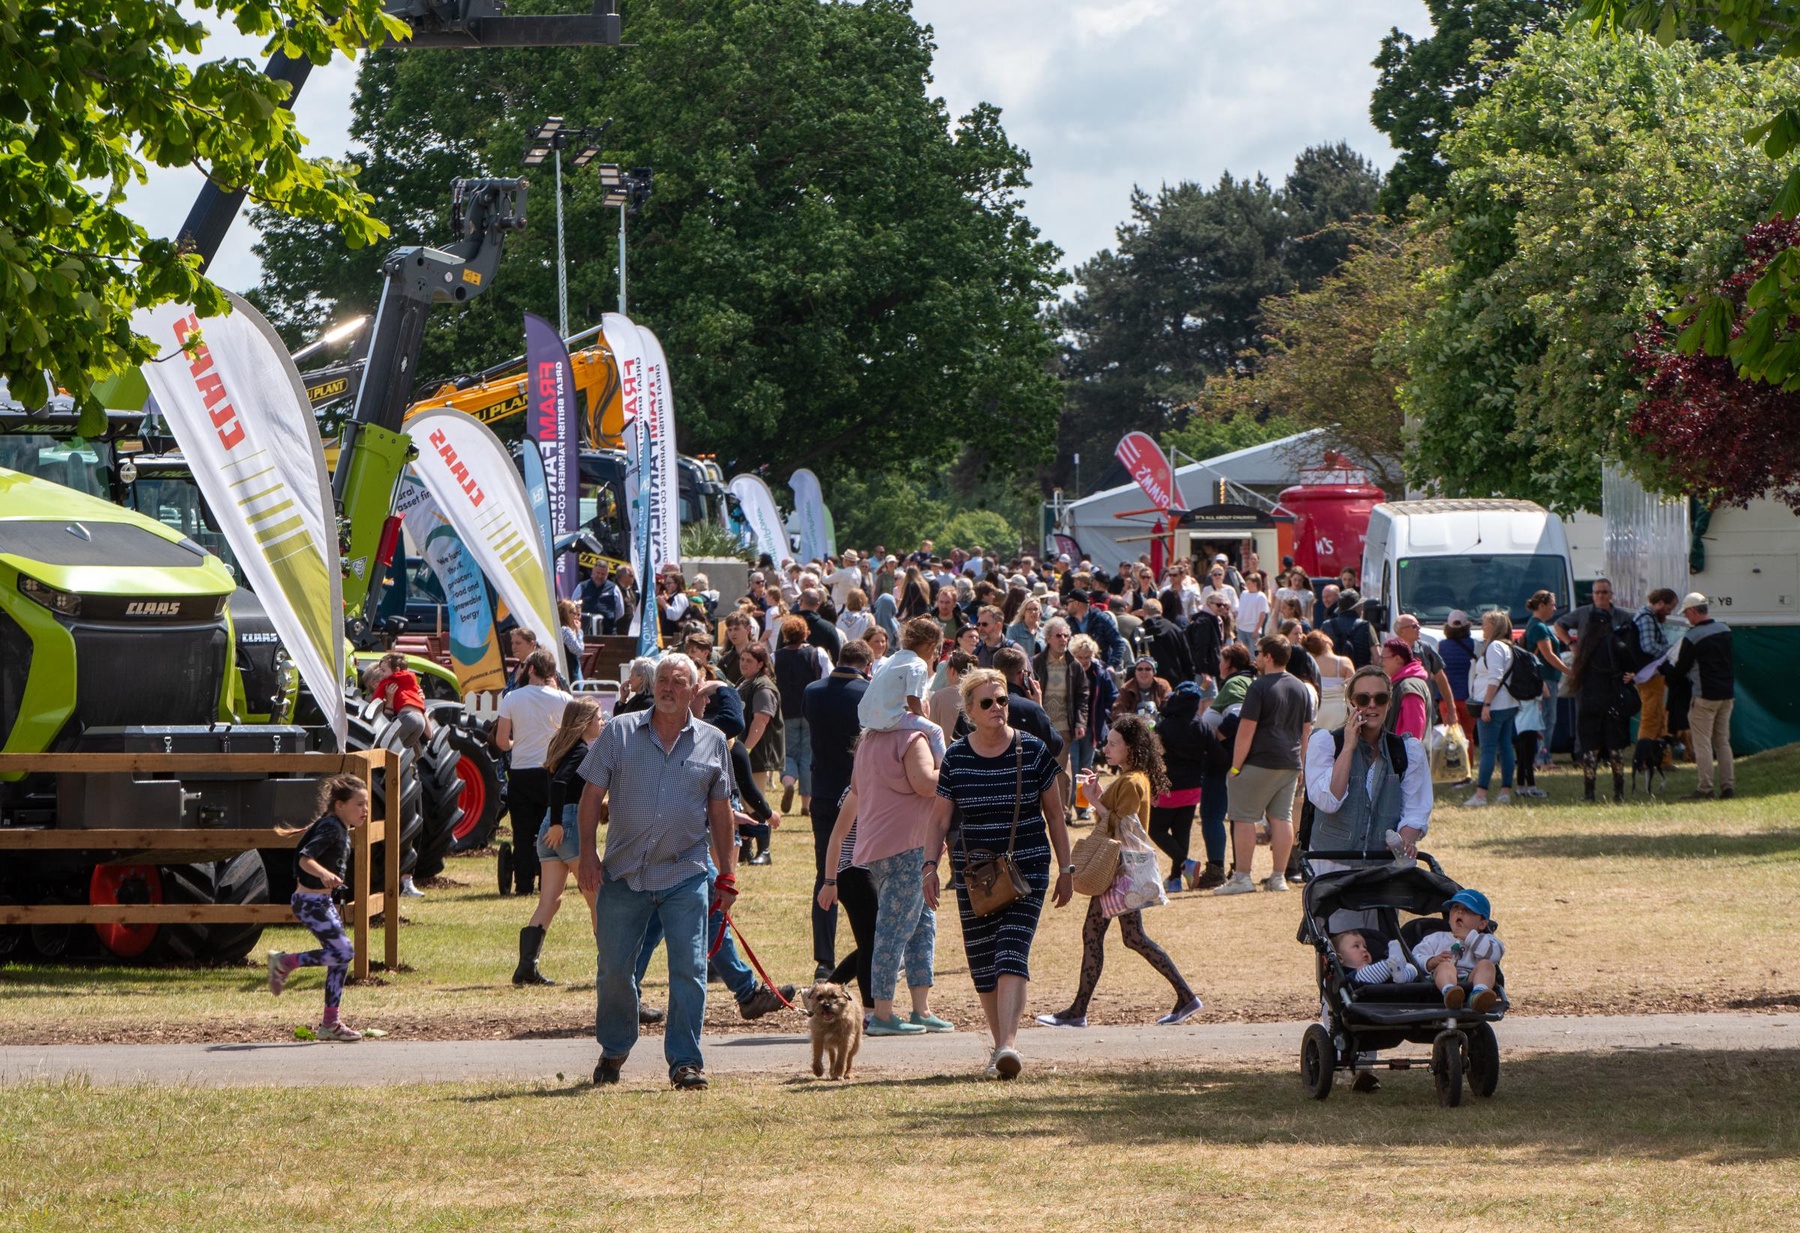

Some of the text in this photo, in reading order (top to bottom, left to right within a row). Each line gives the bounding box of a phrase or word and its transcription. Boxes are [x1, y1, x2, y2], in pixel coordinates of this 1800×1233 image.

[314, 381, 344, 398] PLANT
[397, 495, 420, 512] asset
[125, 602, 181, 615] CLAAS
[242, 633, 277, 643] CLAAS
